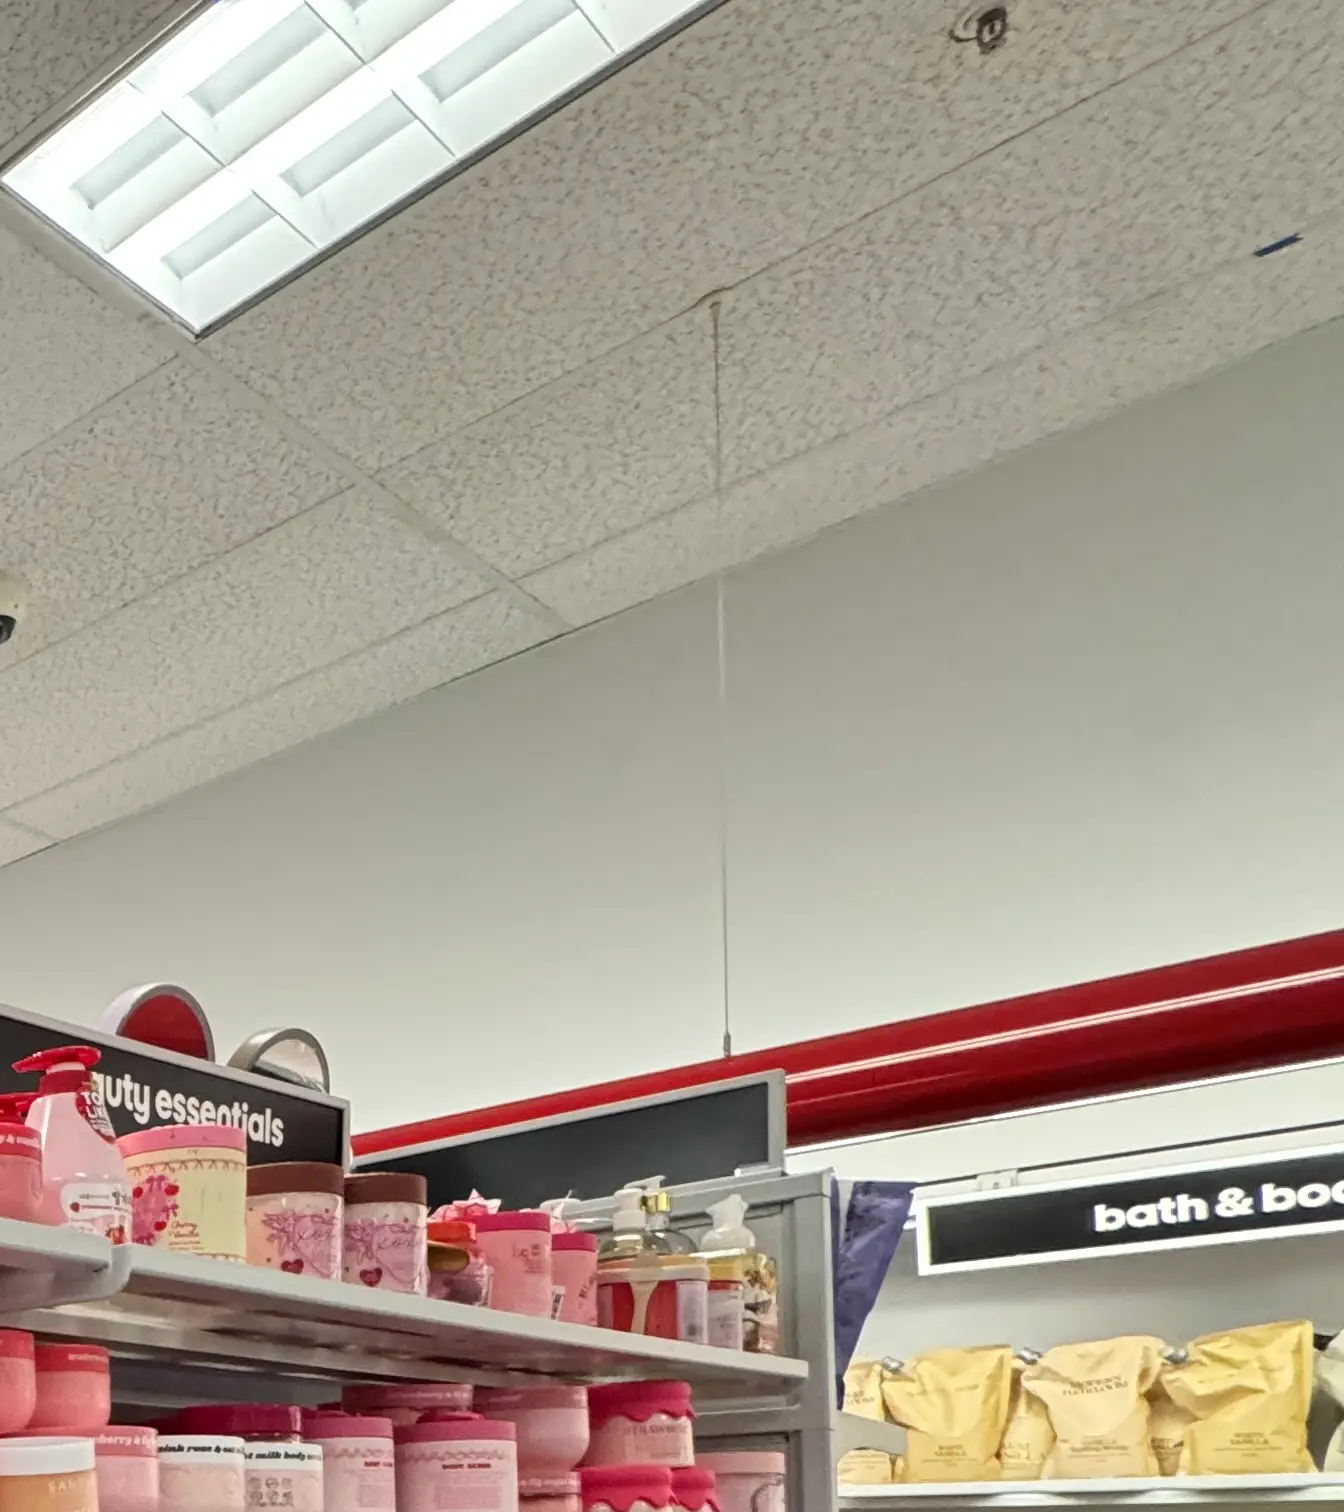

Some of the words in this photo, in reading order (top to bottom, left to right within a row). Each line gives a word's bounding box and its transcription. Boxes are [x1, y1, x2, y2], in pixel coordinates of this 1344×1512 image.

[155, 1087, 285, 1148] essentials
[1093, 1193, 1210, 1233] bath
[1214, 1186, 1256, 1218] &
